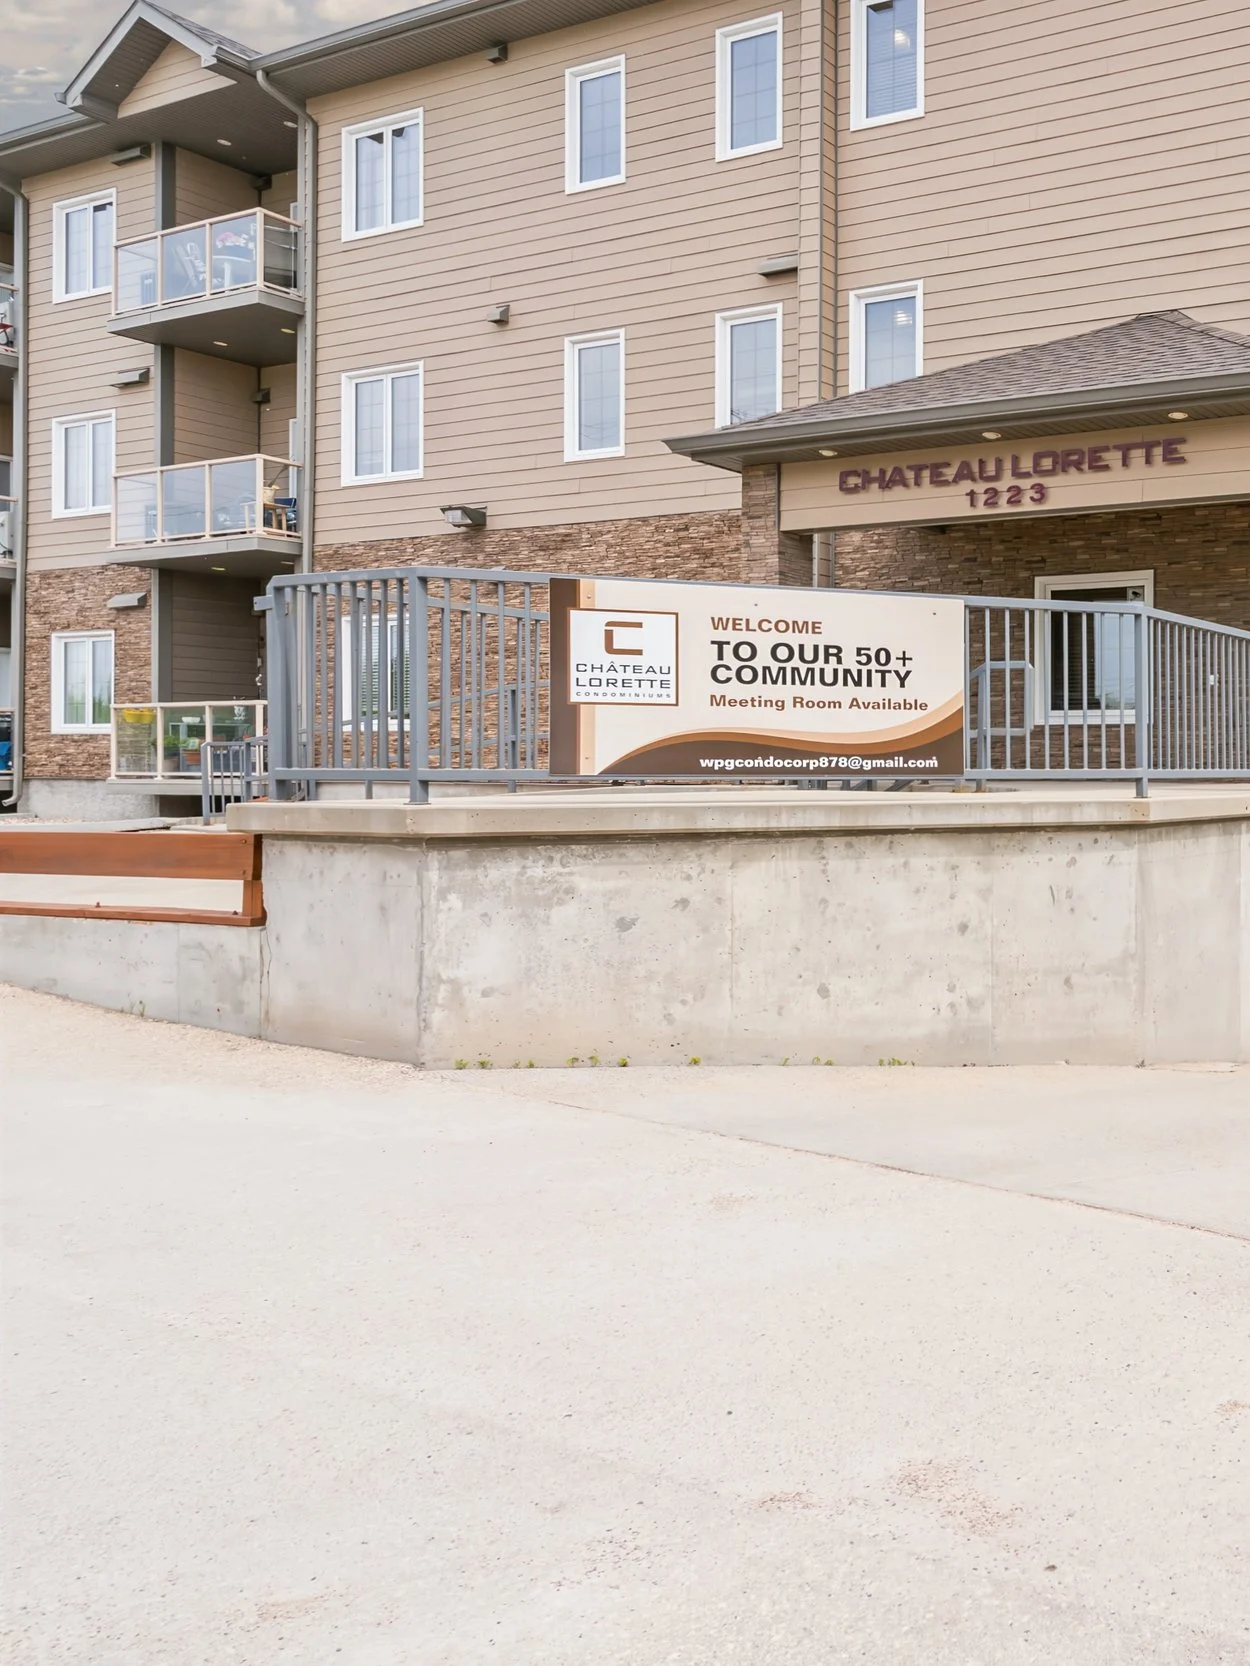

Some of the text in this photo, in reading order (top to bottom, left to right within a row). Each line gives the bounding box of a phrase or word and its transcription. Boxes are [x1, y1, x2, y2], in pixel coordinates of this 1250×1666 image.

[838, 437, 1188, 494] CHATEAU LORETTE
[965, 482, 1048, 508] 1223
[710, 616, 823, 635] WELCOME
[710, 640, 913, 667] TO OUR 50+
[576, 661, 671, 675] CHÂTEAU
[710, 664, 912, 689] COMMUNITY
[576, 677, 671, 689] LORETTE
[575, 691, 671, 699] CONDOMINIUMS
[710, 694, 929, 711] Meeting Room Available
[700, 755, 938, 770] wpgcondocorp878@gmail.com
